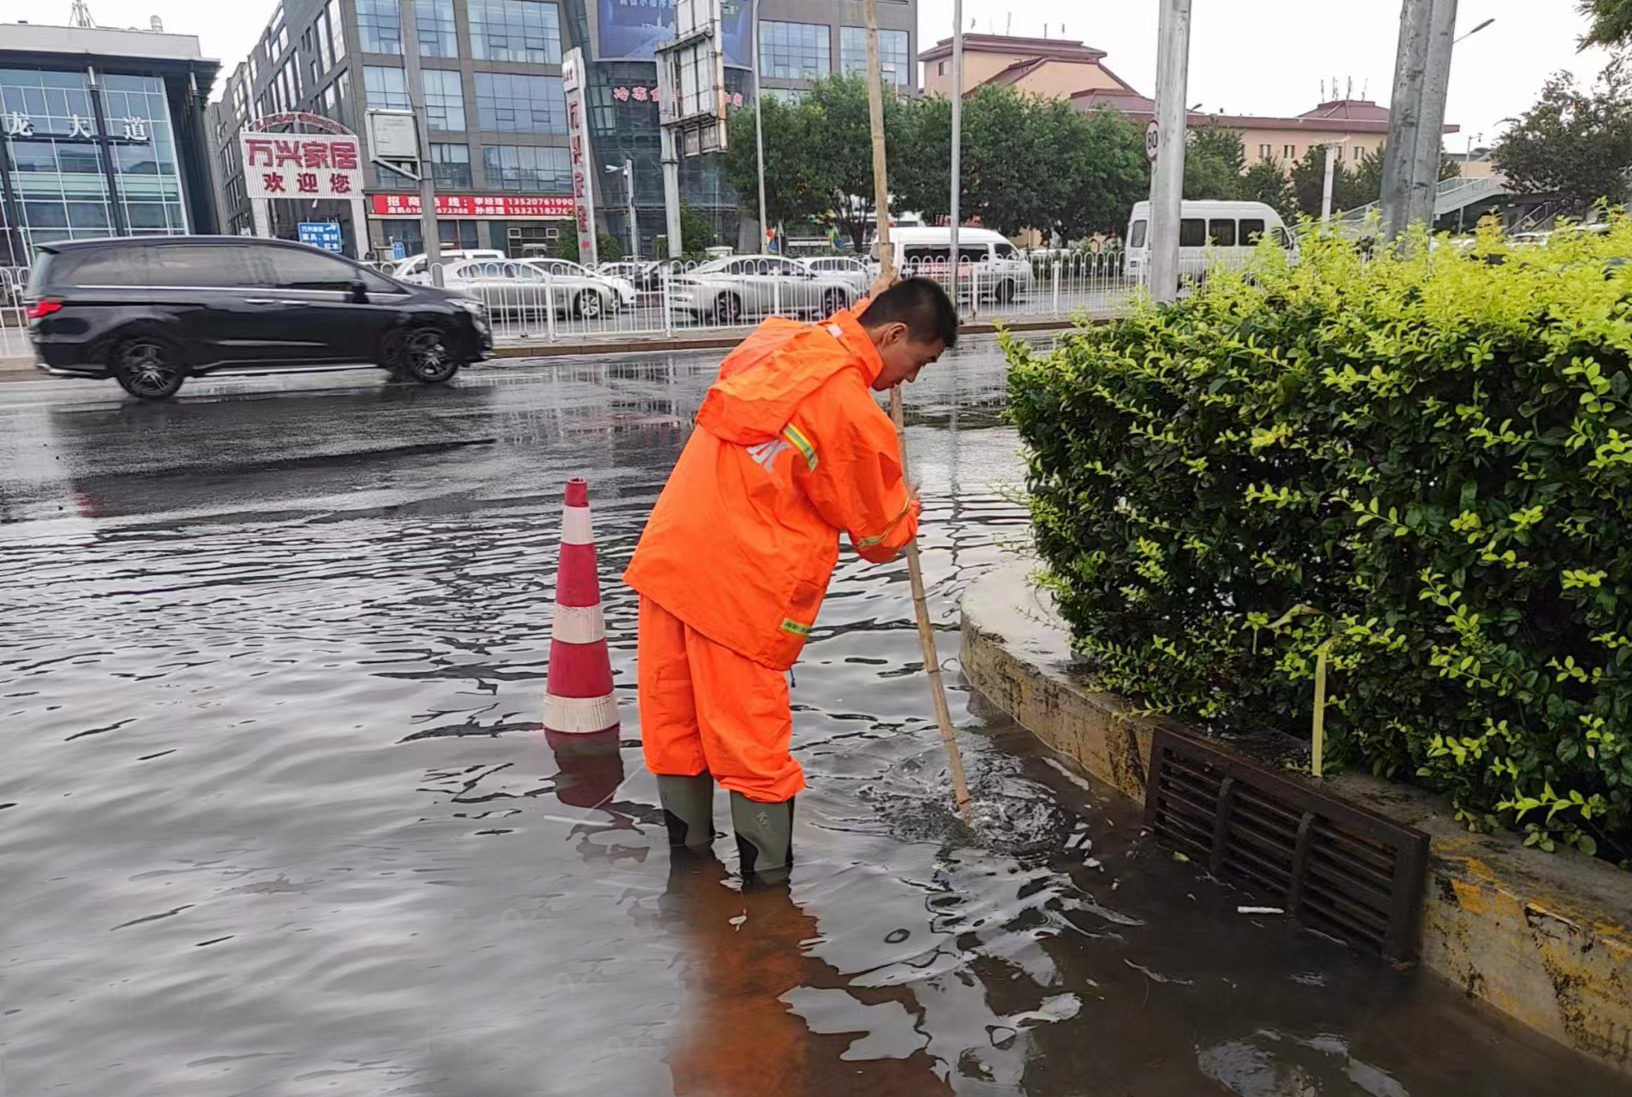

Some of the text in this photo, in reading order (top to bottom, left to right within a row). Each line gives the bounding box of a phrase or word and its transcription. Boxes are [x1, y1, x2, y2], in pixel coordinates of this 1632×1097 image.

[9, 111, 149, 140] 龙大道
[245, 139, 357, 169] 万兴家居
[262, 172, 351, 193] 欢迎您
[508, 207, 574, 215] 1532118276
